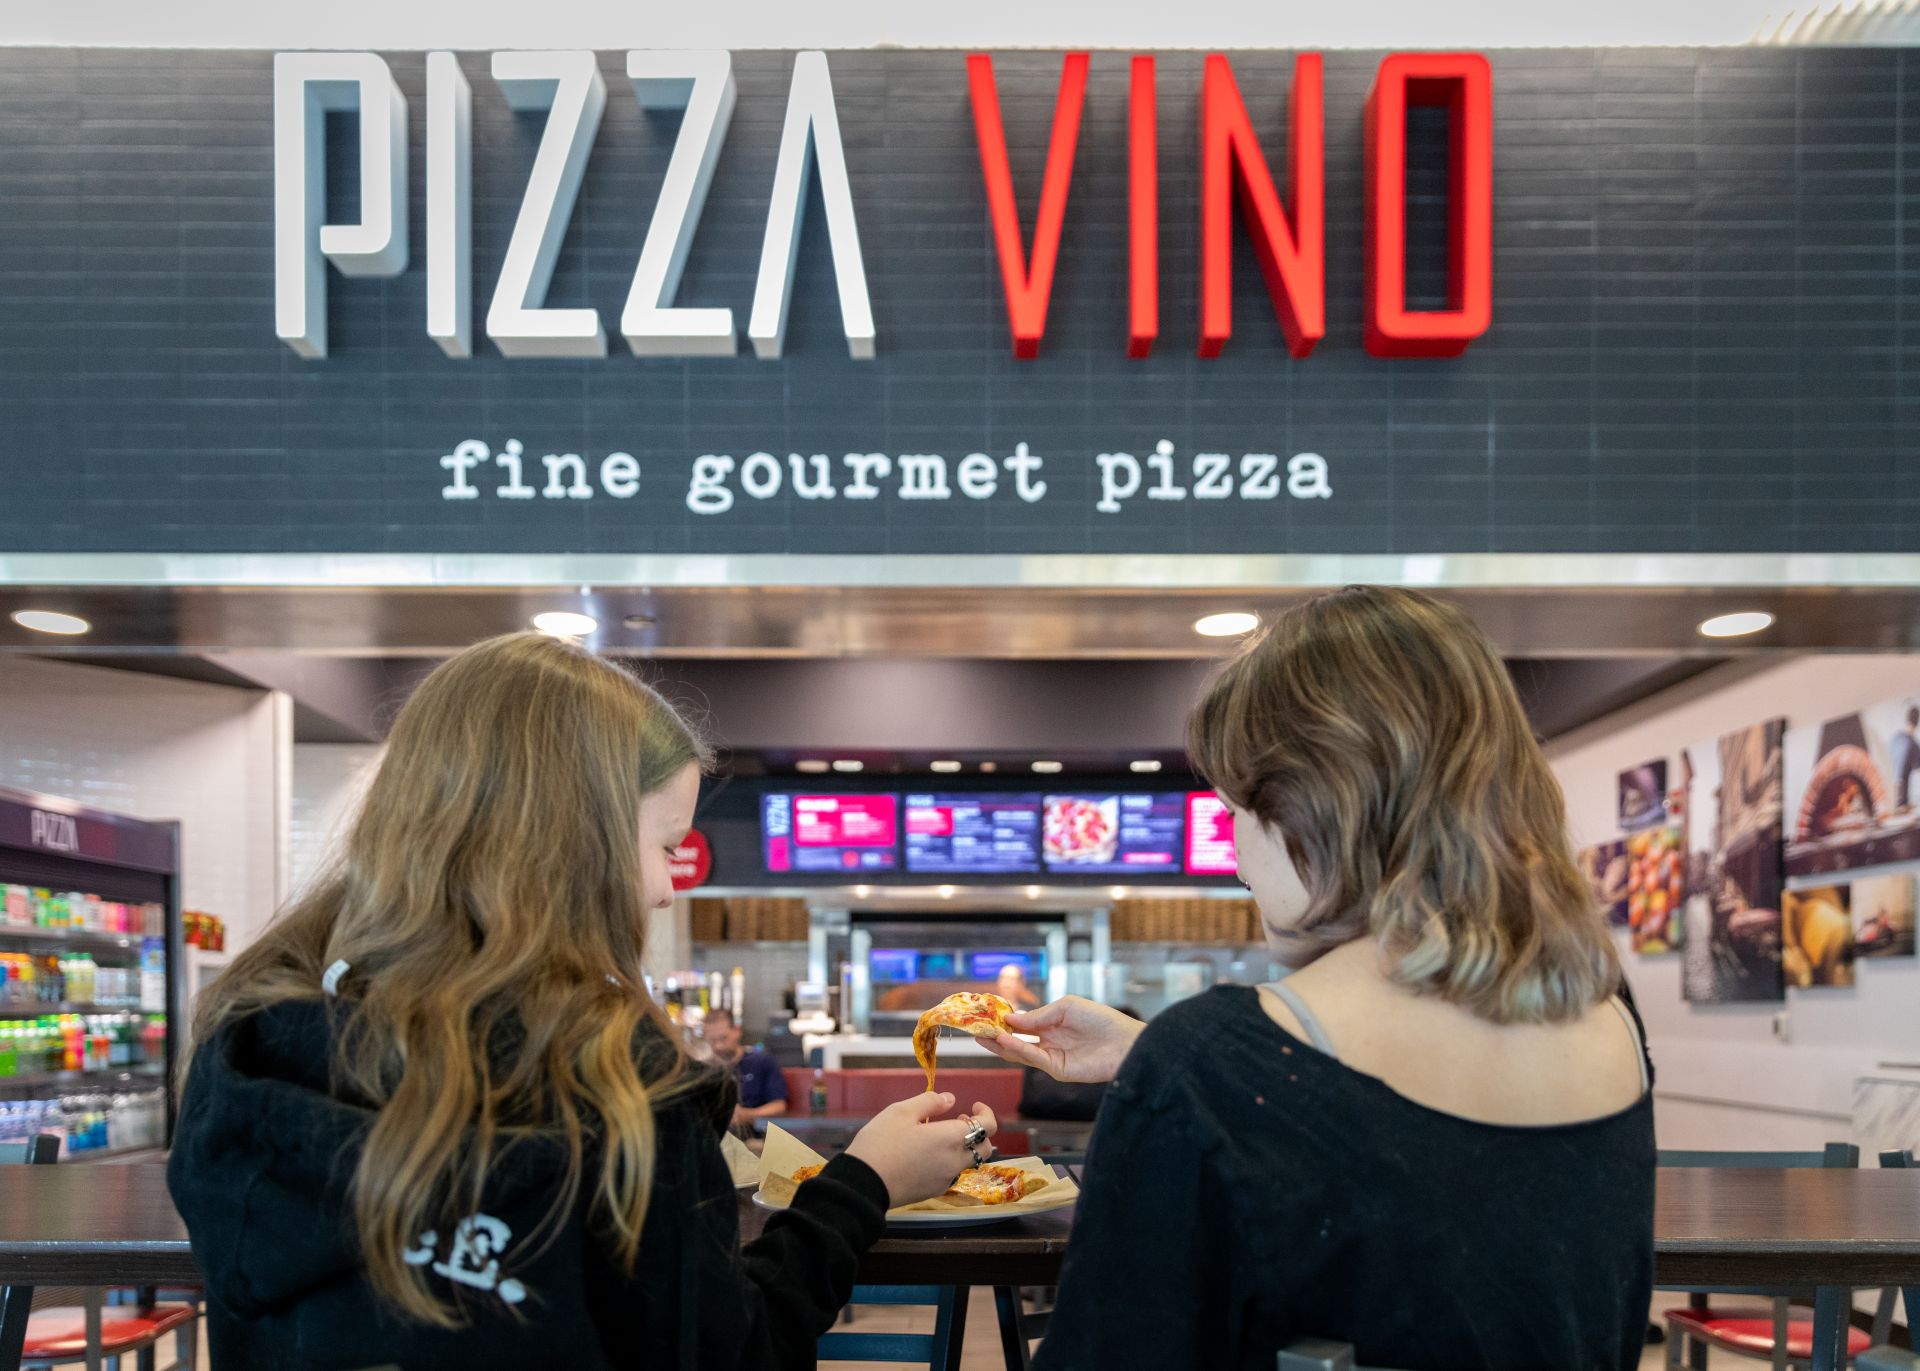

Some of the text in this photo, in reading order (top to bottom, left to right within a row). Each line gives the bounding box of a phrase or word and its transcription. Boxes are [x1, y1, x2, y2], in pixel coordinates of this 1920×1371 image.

[274, 50, 1493, 360] PIZZA VINO
[440, 439, 1333, 515] fine gourmet pizza
